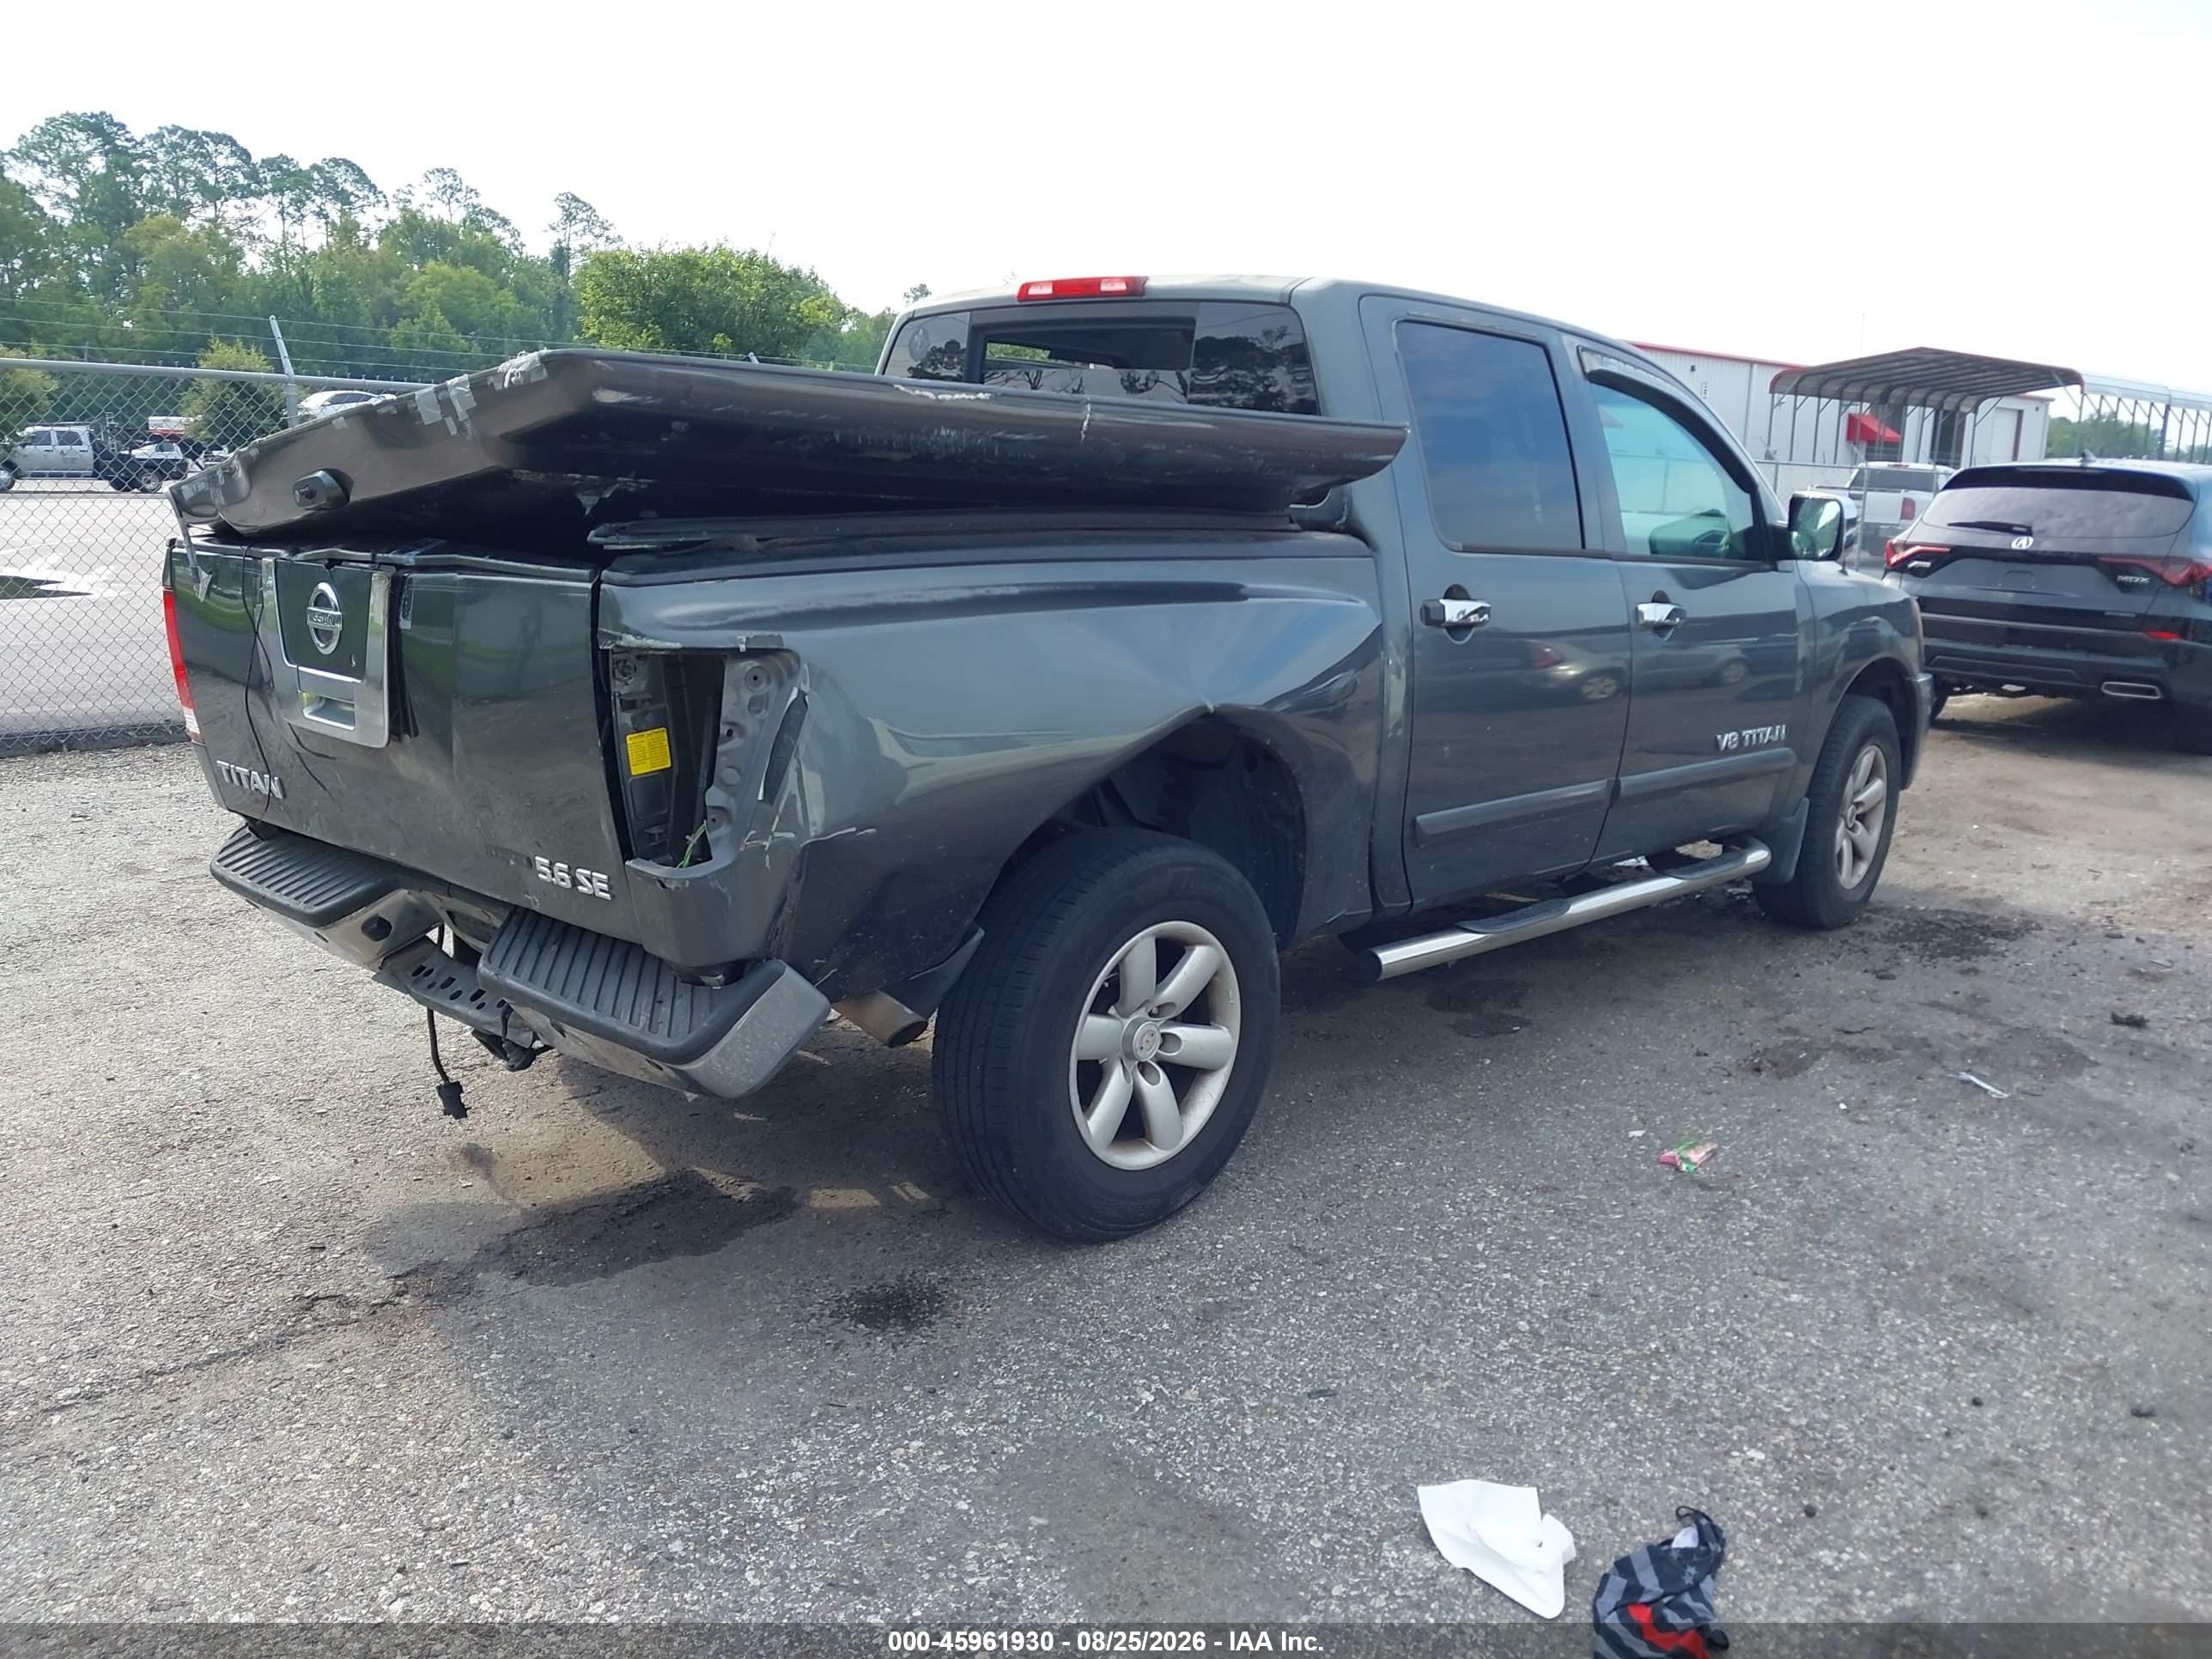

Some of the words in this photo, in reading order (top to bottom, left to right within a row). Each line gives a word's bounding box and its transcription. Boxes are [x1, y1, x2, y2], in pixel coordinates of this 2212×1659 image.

[1717, 732, 1739, 751] V8
[1741, 725, 1786, 747] TITAN
[216, 760, 283, 799] TITAN
[535, 856, 573, 889] 5.6
[575, 868, 611, 901] SE
